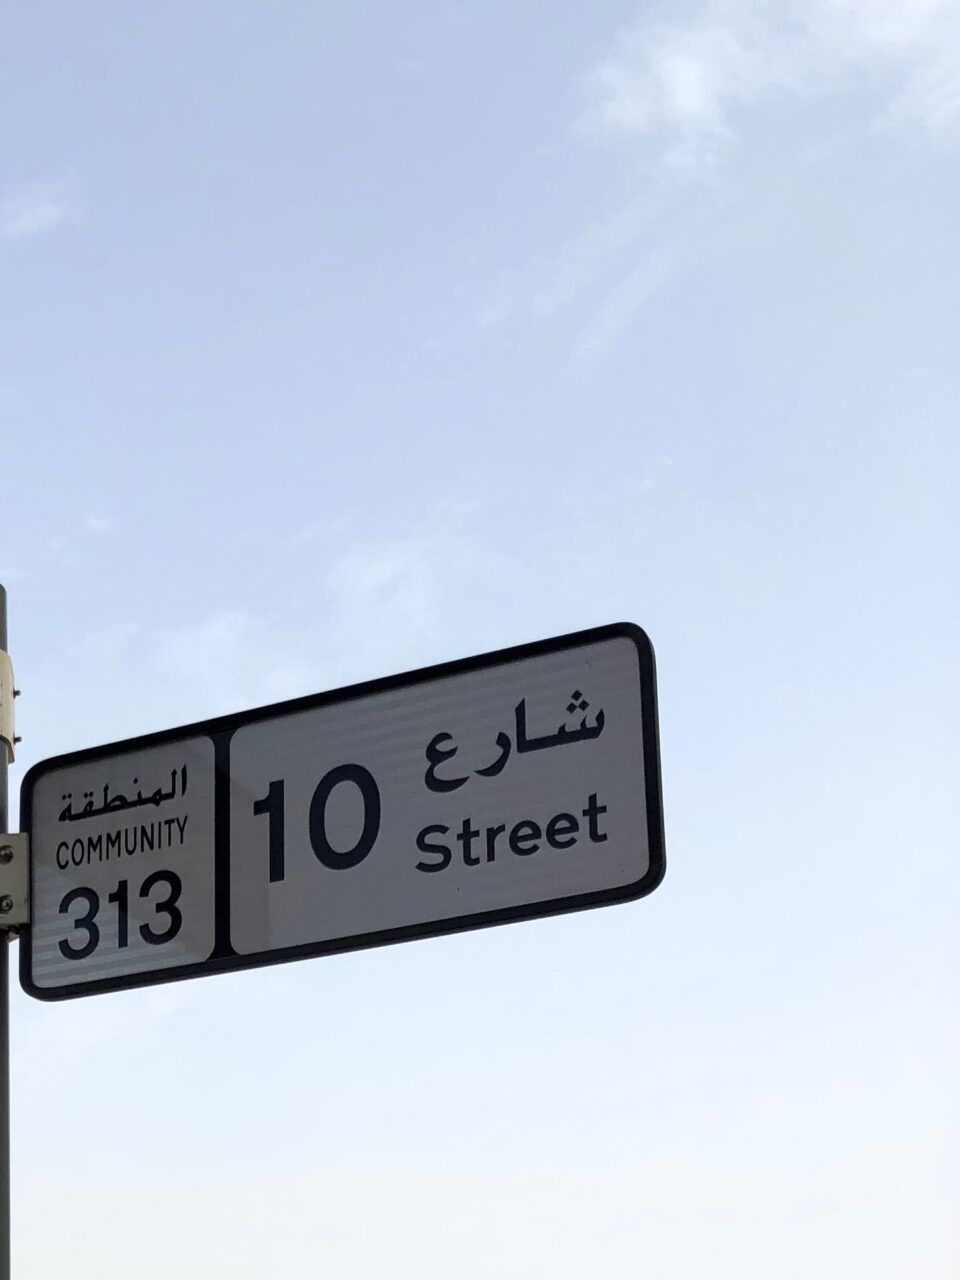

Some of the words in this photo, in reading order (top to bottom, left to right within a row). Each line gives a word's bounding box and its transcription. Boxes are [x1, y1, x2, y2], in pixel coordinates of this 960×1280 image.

[424, 689, 606, 794] شارع
[56, 762, 189, 823] المنطقة
[252, 762, 382, 884] 10
[414, 792, 609, 874] Street
[55, 813, 190, 871] COMMUNITY
[57, 868, 183, 961] 313
